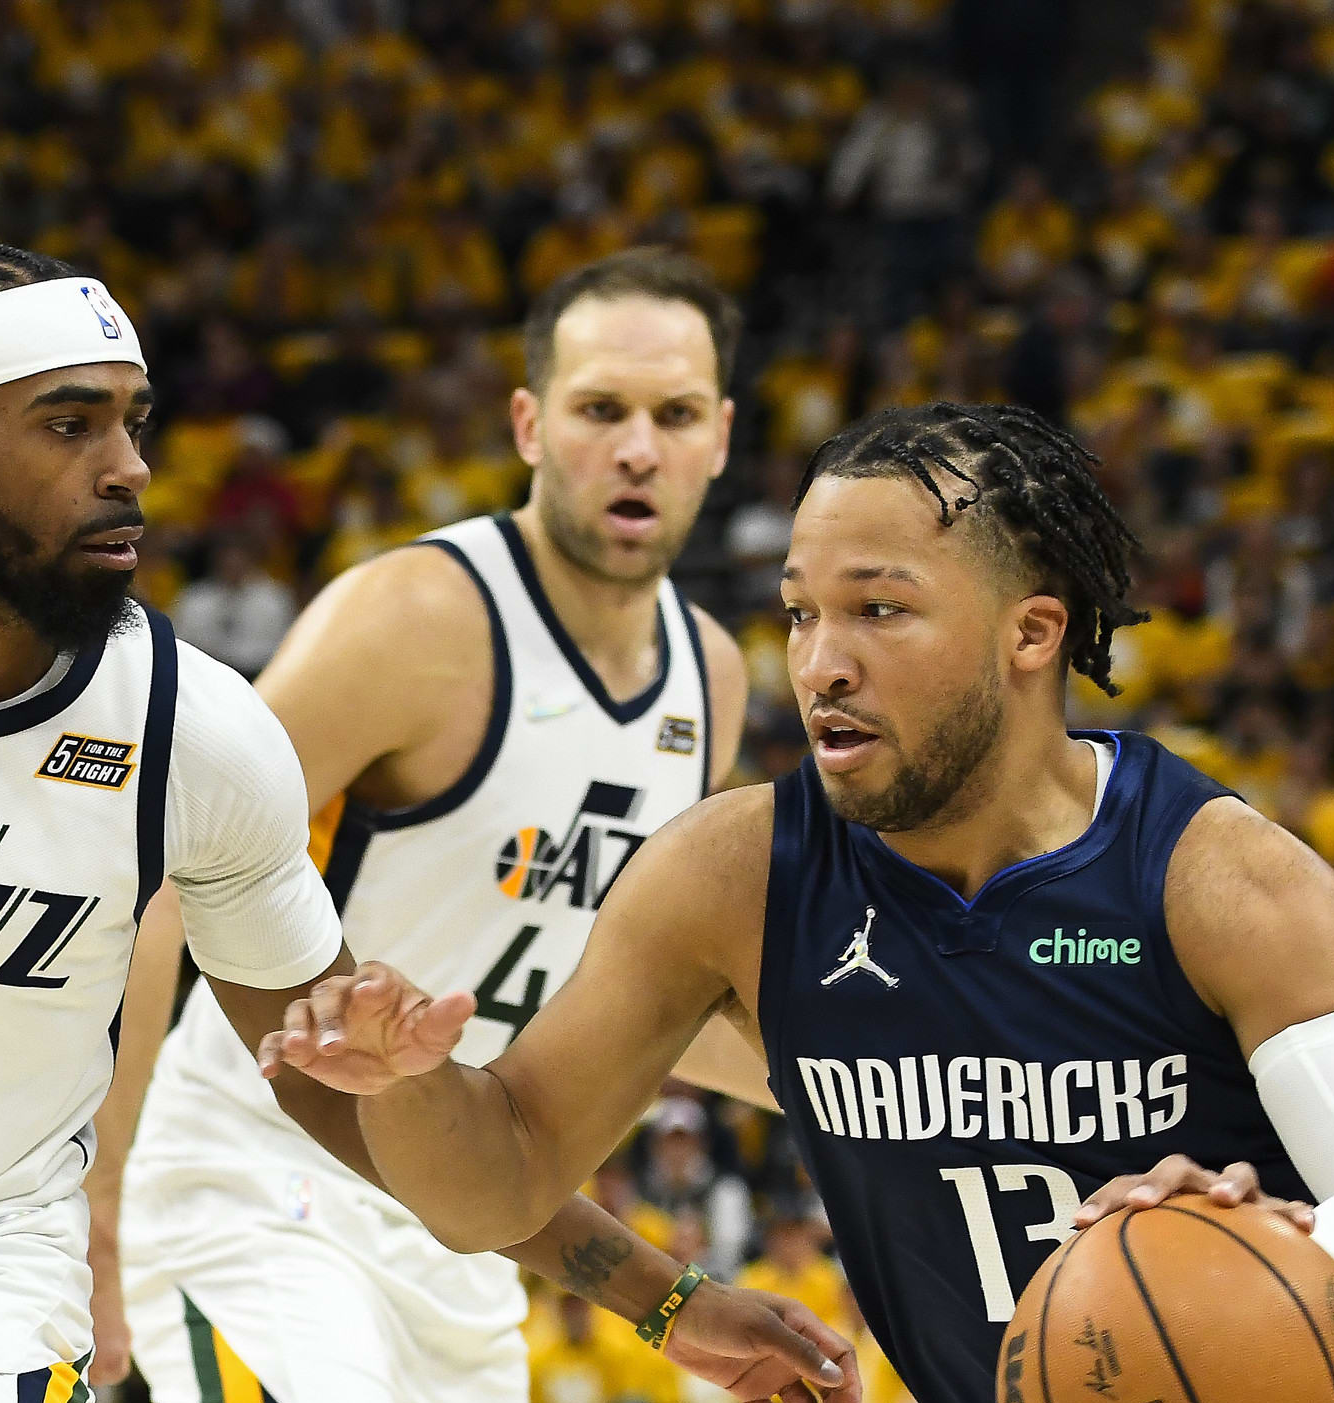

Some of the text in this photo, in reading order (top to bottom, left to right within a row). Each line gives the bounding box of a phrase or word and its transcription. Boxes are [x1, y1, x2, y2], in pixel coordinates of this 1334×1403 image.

[47, 739, 78, 774] 5
[84, 743, 126, 758] FOR THE
[70, 761, 125, 783] FIGHT
[1028, 927, 1142, 966] chime
[797, 1054, 1187, 1144] MAVERICKS
